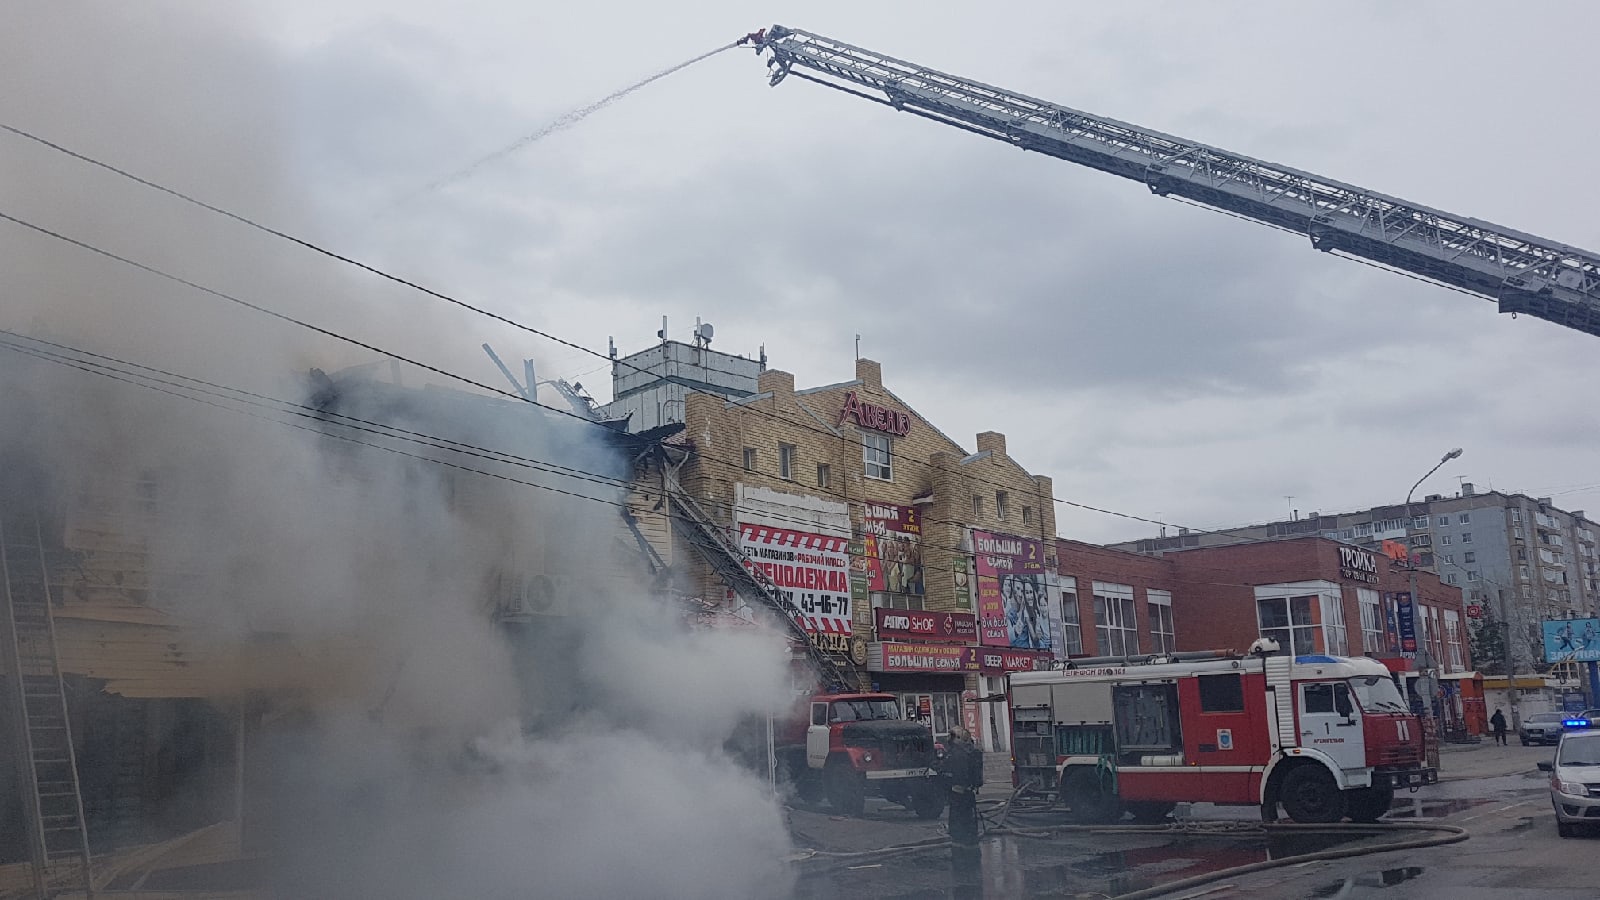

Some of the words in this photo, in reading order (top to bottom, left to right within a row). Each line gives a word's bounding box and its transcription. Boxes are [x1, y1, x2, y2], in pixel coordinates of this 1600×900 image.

[743, 545, 759, 557] СЕТЬ
[759, 546, 794, 562] МАГАЗИНОВ
[977, 537, 1023, 555] БОЛЬШАЯ
[1029, 543, 1036, 559] 2
[1339, 547, 1378, 574] ТРОЙКА
[801, 592, 849, 615] 43-16-77
[883, 615, 910, 630] АЛКО
[911, 616, 935, 632] SHOP
[887, 644, 914, 653] МАГАЗИН
[914, 645, 940, 655] ОДЕЖДЫ
[970, 649, 976, 662] 2
[888, 655, 934, 668] БОЛЬШАЯ
[983, 654, 1003, 668] BEER
[1005, 656, 1031, 669] MARKET
[968, 712, 975, 728] 2
[1324, 721, 1330, 735] 1
